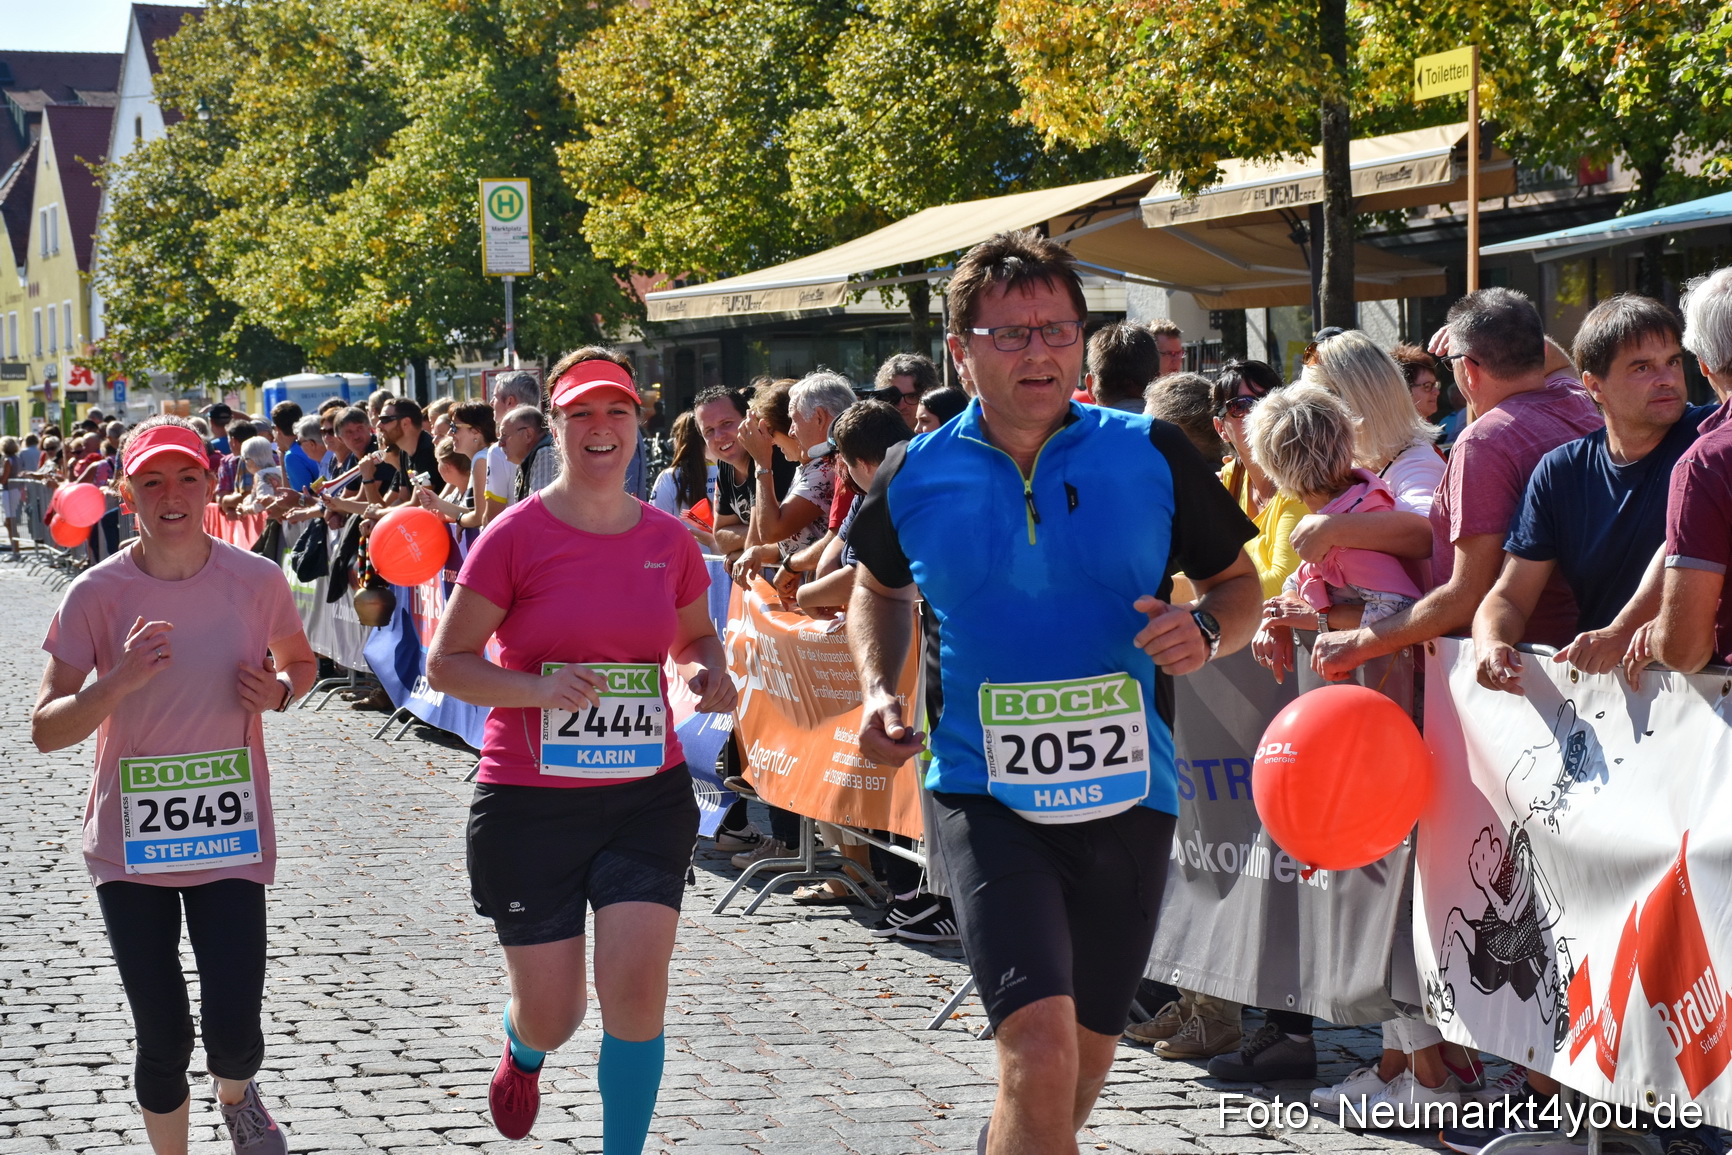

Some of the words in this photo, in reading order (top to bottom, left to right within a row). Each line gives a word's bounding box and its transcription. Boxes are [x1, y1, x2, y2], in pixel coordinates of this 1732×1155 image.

[1425, 63, 1469, 86] Toiletten
[491, 225, 522, 234] Marktplatz
[643, 560, 666, 569] asics
[816, 648, 852, 667] Konzeptio
[991, 678, 1130, 721] BOCK
[557, 704, 654, 737] 2444
[576, 749, 636, 765] KARIN
[747, 739, 798, 779] Agentur
[1001, 724, 1129, 775] 2052
[1264, 755, 1297, 765] energie
[129, 753, 243, 788] BOCK
[865, 775, 887, 791] 897
[1033, 784, 1104, 807] HANS
[137, 791, 242, 833] 2649
[144, 836, 242, 860] STEFANIE
[1651, 965, 1722, 1059] Braun
[1699, 1031, 1720, 1055] Sicher
